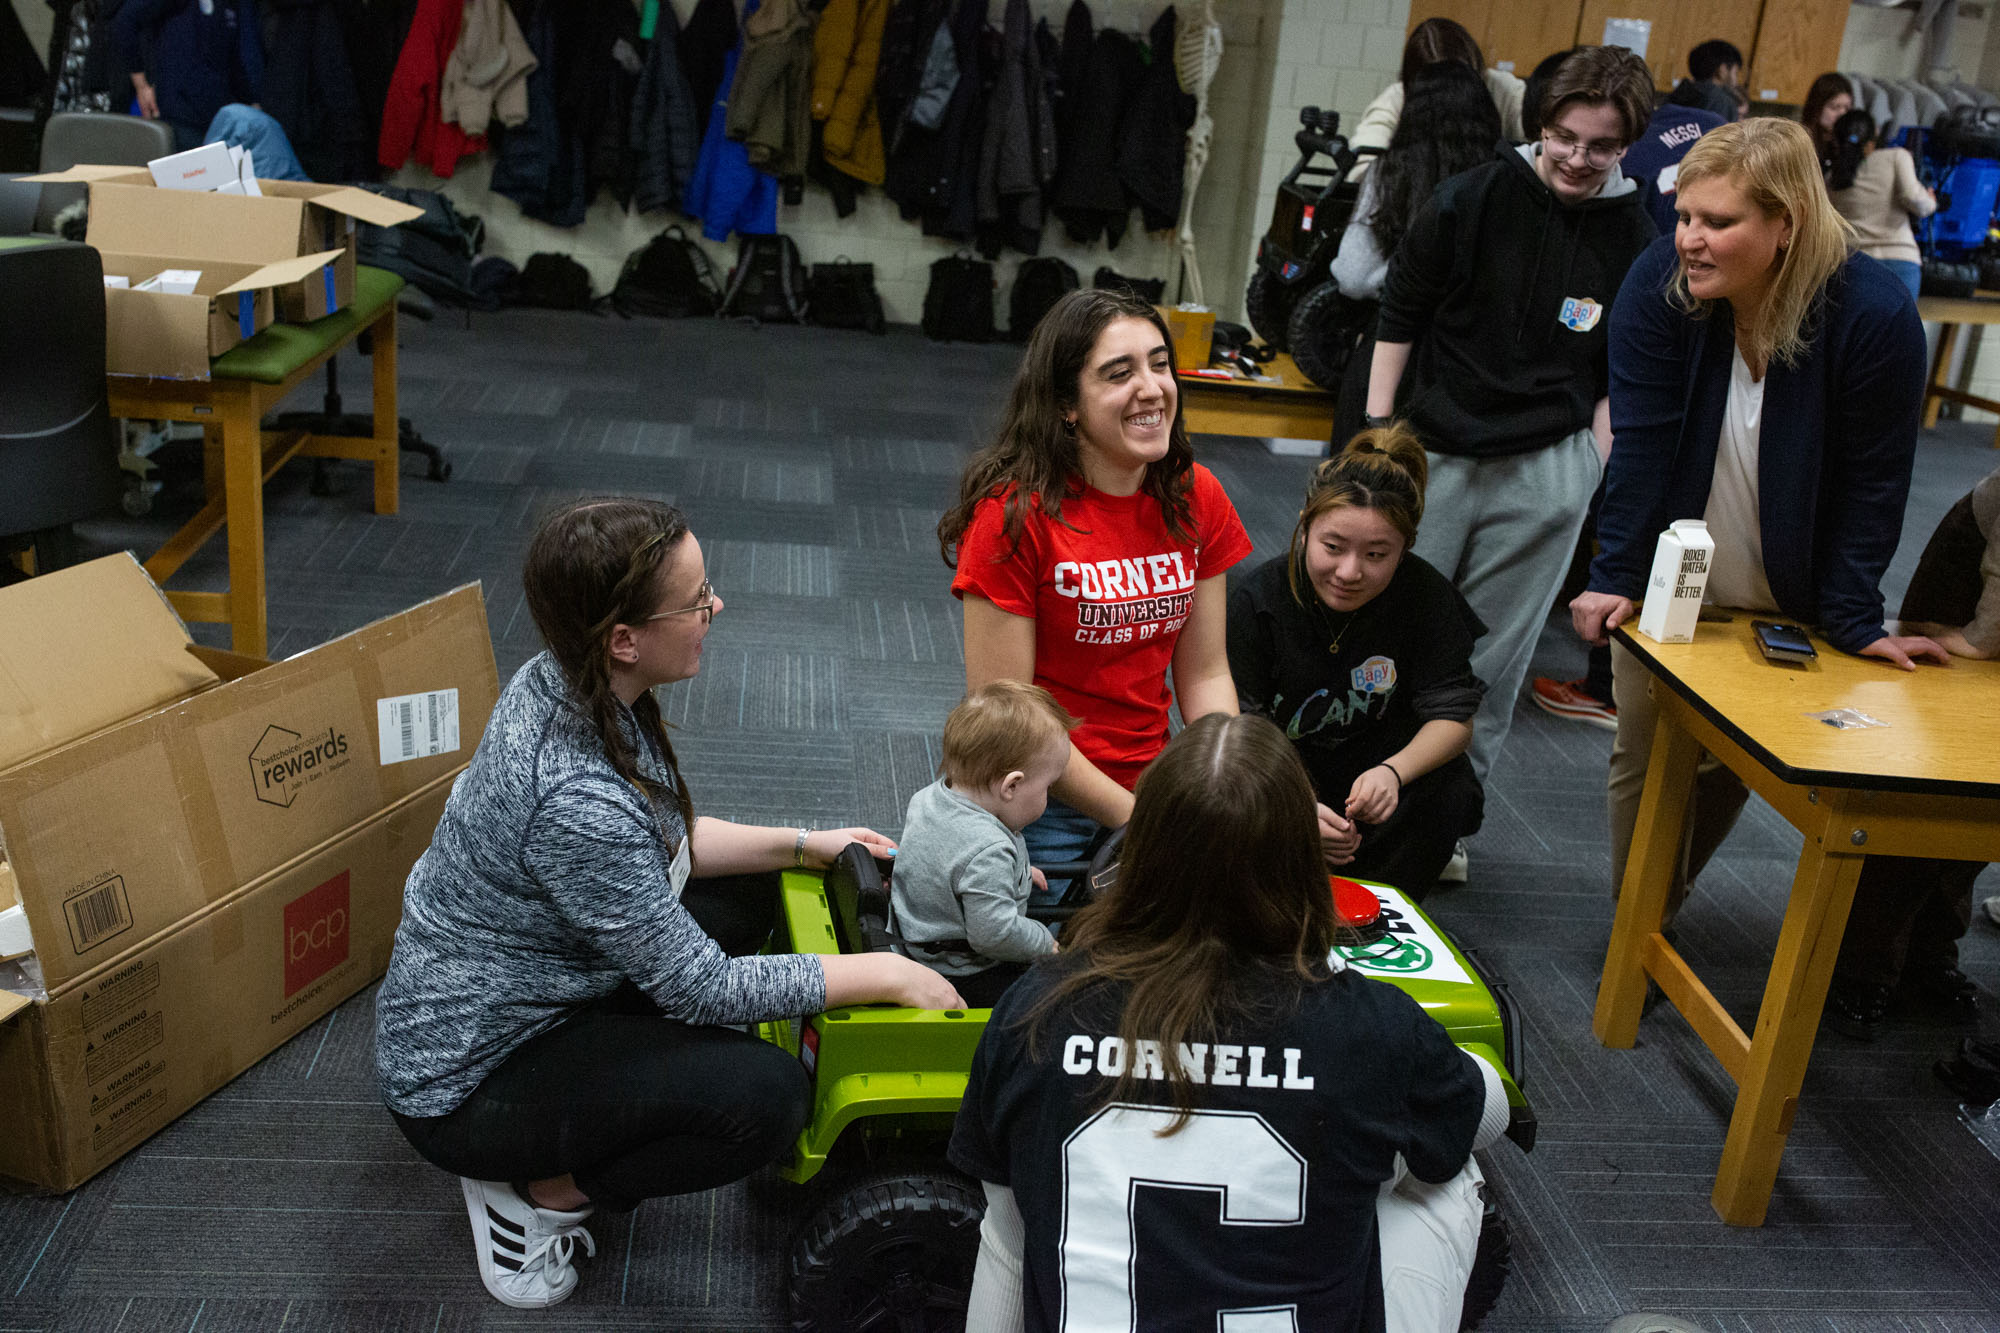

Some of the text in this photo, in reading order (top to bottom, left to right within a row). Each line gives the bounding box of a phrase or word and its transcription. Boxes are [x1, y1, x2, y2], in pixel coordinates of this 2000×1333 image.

[1659, 122, 1702, 149] MESSI
[1680, 561, 1704, 574] WATER
[1683, 548, 1706, 561] BOXED
[1674, 586, 1702, 598] BETTER.
[1677, 574, 1686, 586] IS
[1075, 627, 1133, 645] CLASS
[1140, 623, 1159, 640] OF
[65, 882, 87, 897] MADE
[94, 868, 117, 882] CHINA
[289, 908, 346, 965] bcp
[98, 960, 144, 991] WARNING
[102, 1009, 147, 1041] WARNING
[106, 1060, 151, 1092] WARNING
[1062, 1034, 1315, 1091] CORNELL
[109, 1088, 153, 1121] WARNING
